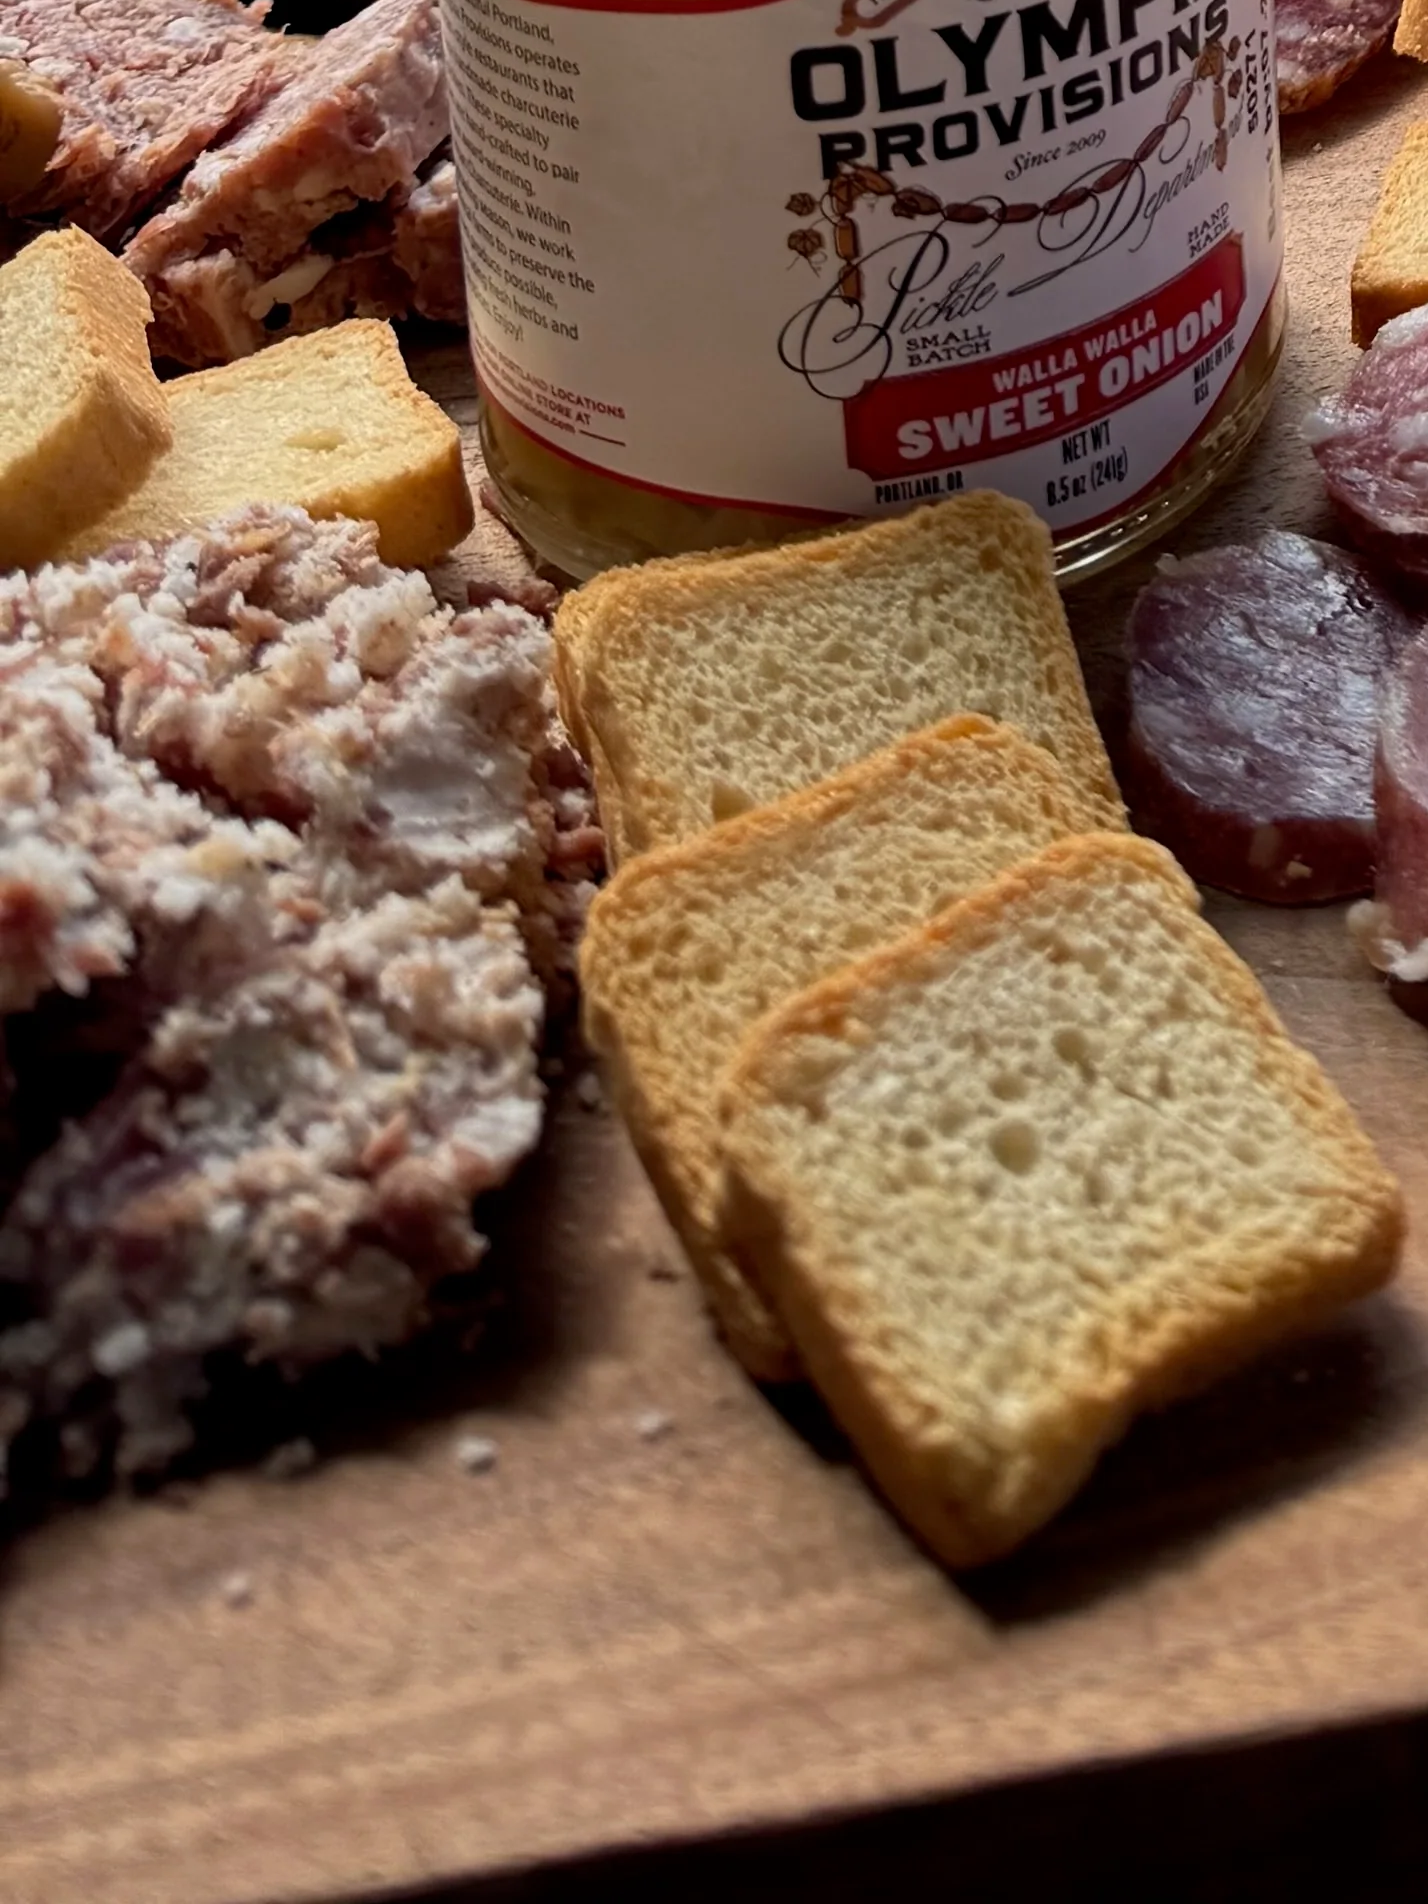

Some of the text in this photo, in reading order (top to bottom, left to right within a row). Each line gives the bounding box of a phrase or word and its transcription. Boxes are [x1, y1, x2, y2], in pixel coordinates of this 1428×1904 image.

[475, 49, 576, 103] restaurants that
[515, 46, 581, 76] operates
[493, 111, 549, 151] specialty
[501, 91, 580, 131] charcuterie
[533, 154, 549, 173] to
[551, 162, 580, 184] pair
[1004, 128, 1107, 181] Since 2009
[524, 201, 571, 234] Within
[1187, 201, 1230, 243] HAND
[1189, 215, 1231, 259] MADE
[516, 226, 536, 247] we
[539, 239, 575, 262] work
[495, 238, 507, 256] to
[509, 248, 566, 284] preserve
[568, 270, 595, 293] the
[504, 268, 559, 311] possible,
[513, 294, 549, 329] herbs
[552, 319, 580, 341] and
[778, 228, 1006, 401] Pickle
[906, 324, 993, 352] SMALL
[907, 338, 993, 368] BATCH
[992, 308, 1157, 393] WALLA WALLA
[896, 289, 1224, 461] SWEET ONION
[535, 393, 573, 420] STORE
[576, 411, 592, 426] AT
[551, 383, 626, 420] LOCATIONS
[1062, 418, 1112, 465] NET WT
[946, 469, 964, 492] OR
[1046, 446, 1129, 508] 8.5 oz (241g)
